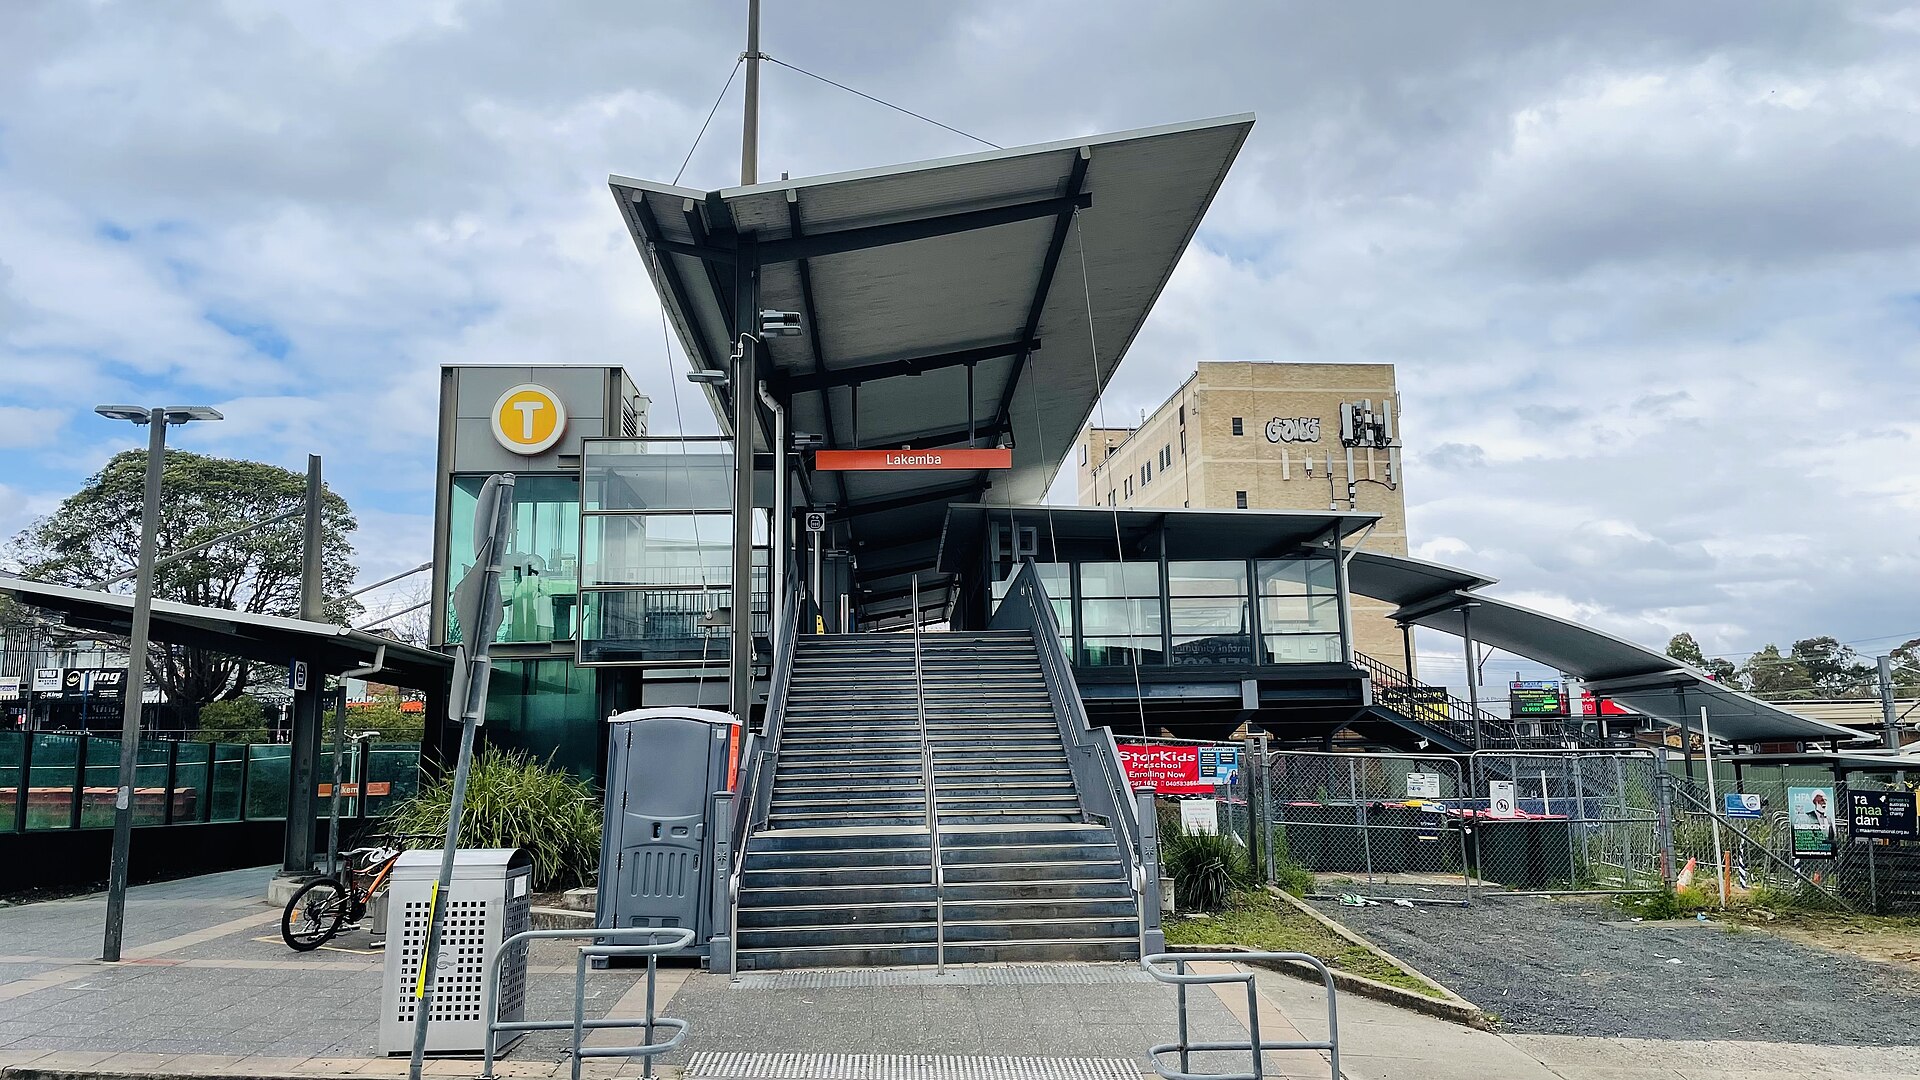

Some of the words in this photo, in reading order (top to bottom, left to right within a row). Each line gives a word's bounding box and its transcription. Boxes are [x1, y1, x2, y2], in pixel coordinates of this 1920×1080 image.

[513, 401, 544, 439] T
[886, 453, 942, 465] Lakemba
[1119, 751, 1196, 762] StarKids
[1129, 771, 1165, 779] Enrolling
[1854, 795, 1868, 805] ra
[1855, 806, 1882, 816] maa
[1855, 815, 1879, 826] dan
